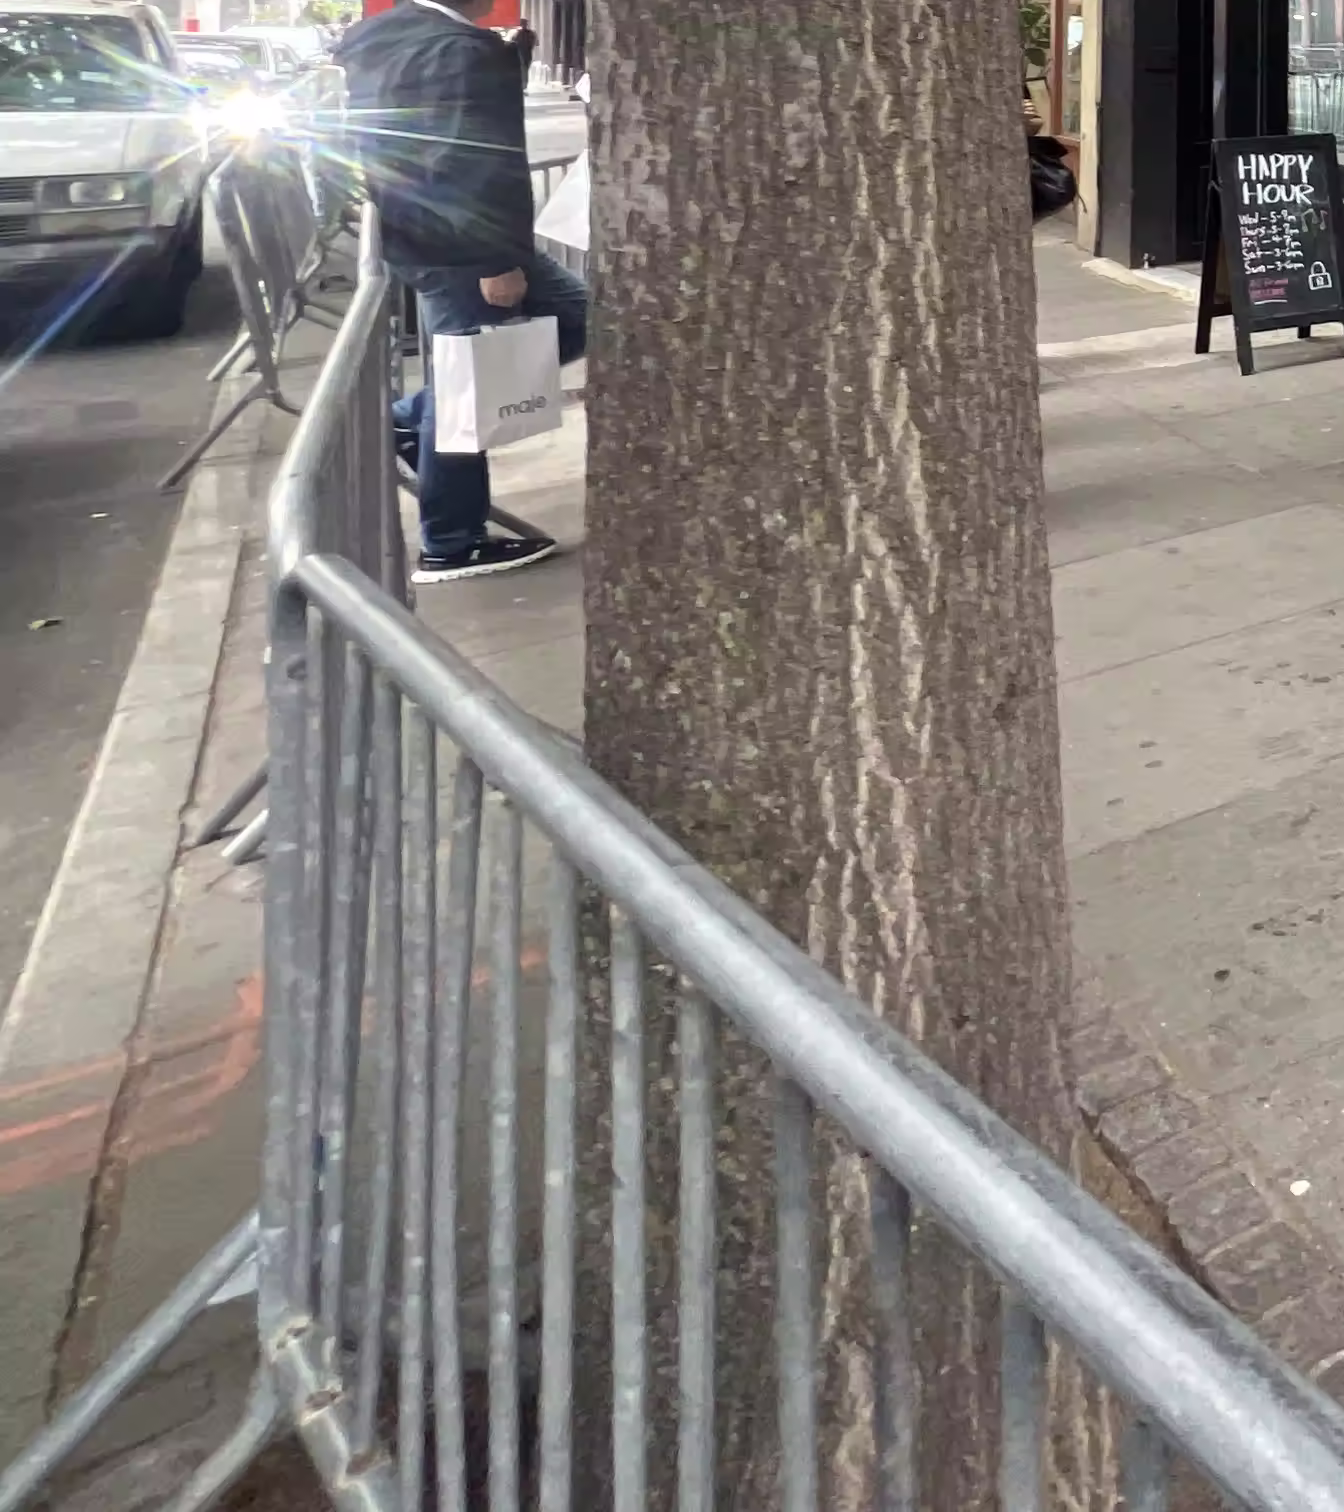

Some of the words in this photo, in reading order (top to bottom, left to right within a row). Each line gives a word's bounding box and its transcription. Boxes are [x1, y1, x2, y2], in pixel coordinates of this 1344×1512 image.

[1238, 153, 1314, 184] HAPPY
[1242, 181, 1314, 205] HOUR
[498, 392, 547, 419] maje
